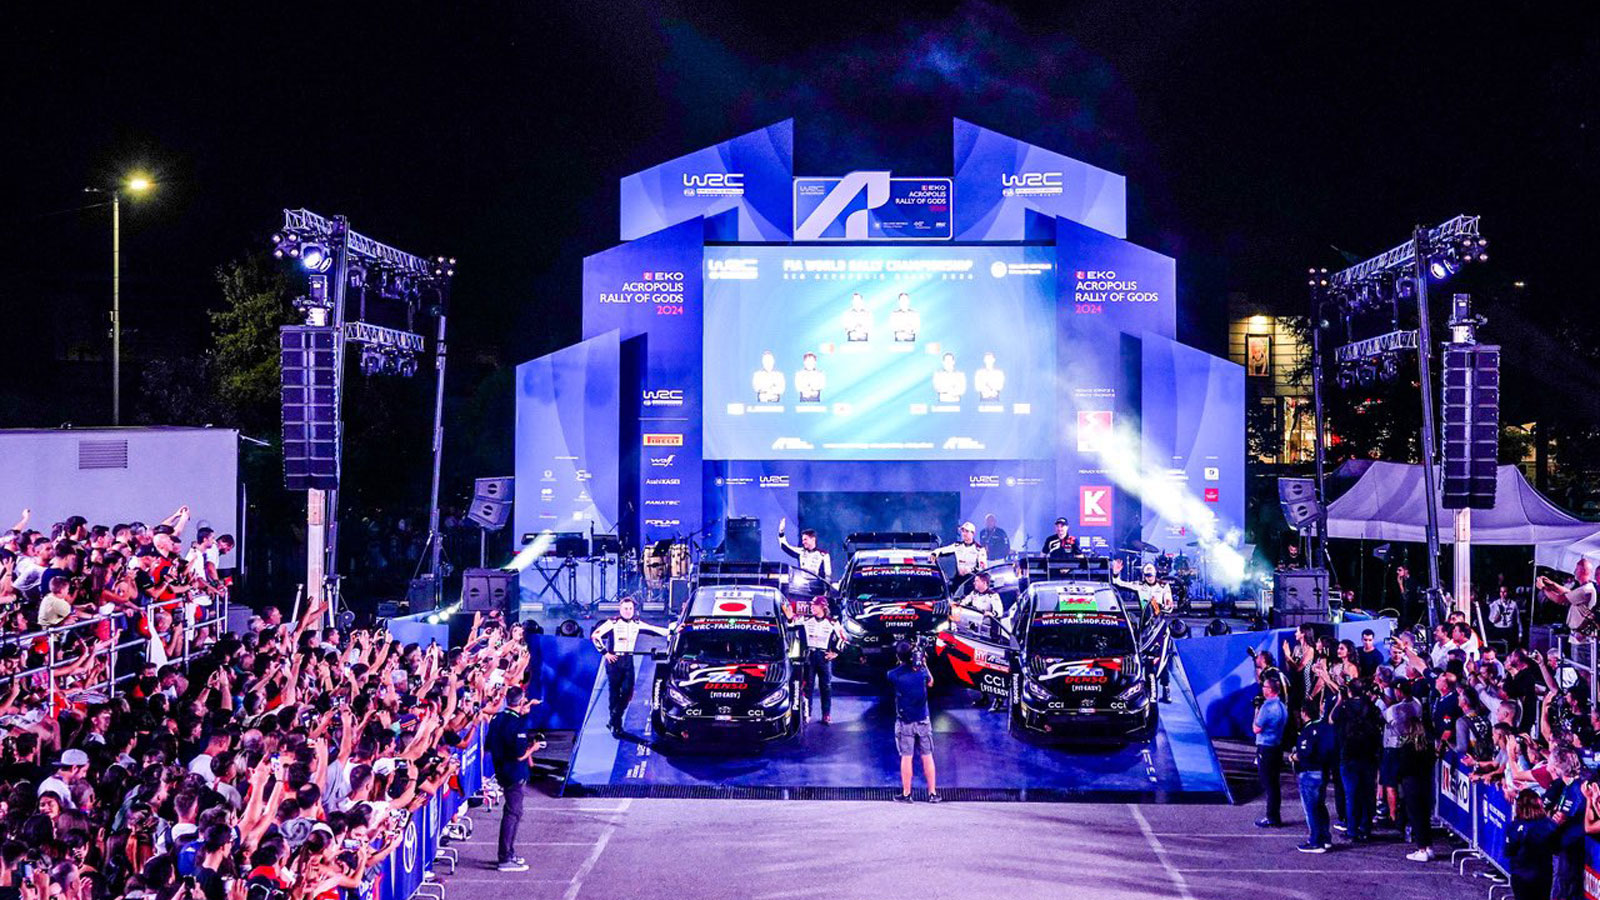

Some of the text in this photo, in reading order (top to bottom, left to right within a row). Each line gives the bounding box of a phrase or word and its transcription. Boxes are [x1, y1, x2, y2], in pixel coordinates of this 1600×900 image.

[683, 173, 744, 186] WRC
[1002, 173, 1063, 186] WRC
[655, 272, 684, 281] EKO
[1087, 271, 1116, 280] EKO
[622, 282, 684, 292] ACROPOLIS
[1076, 281, 1137, 291] ACROPOLIS
[600, 293, 684, 303] RALLY OF GODS
[1075, 292, 1159, 302] RALLY OF GODS
[657, 305, 684, 315] 2024
[1075, 303, 1102, 314] 2024
[643, 390, 683, 399] WRC
[1084, 490, 1106, 515] K
[984, 674, 1005, 687] CCI
[1065, 676, 1108, 684] DENSO
